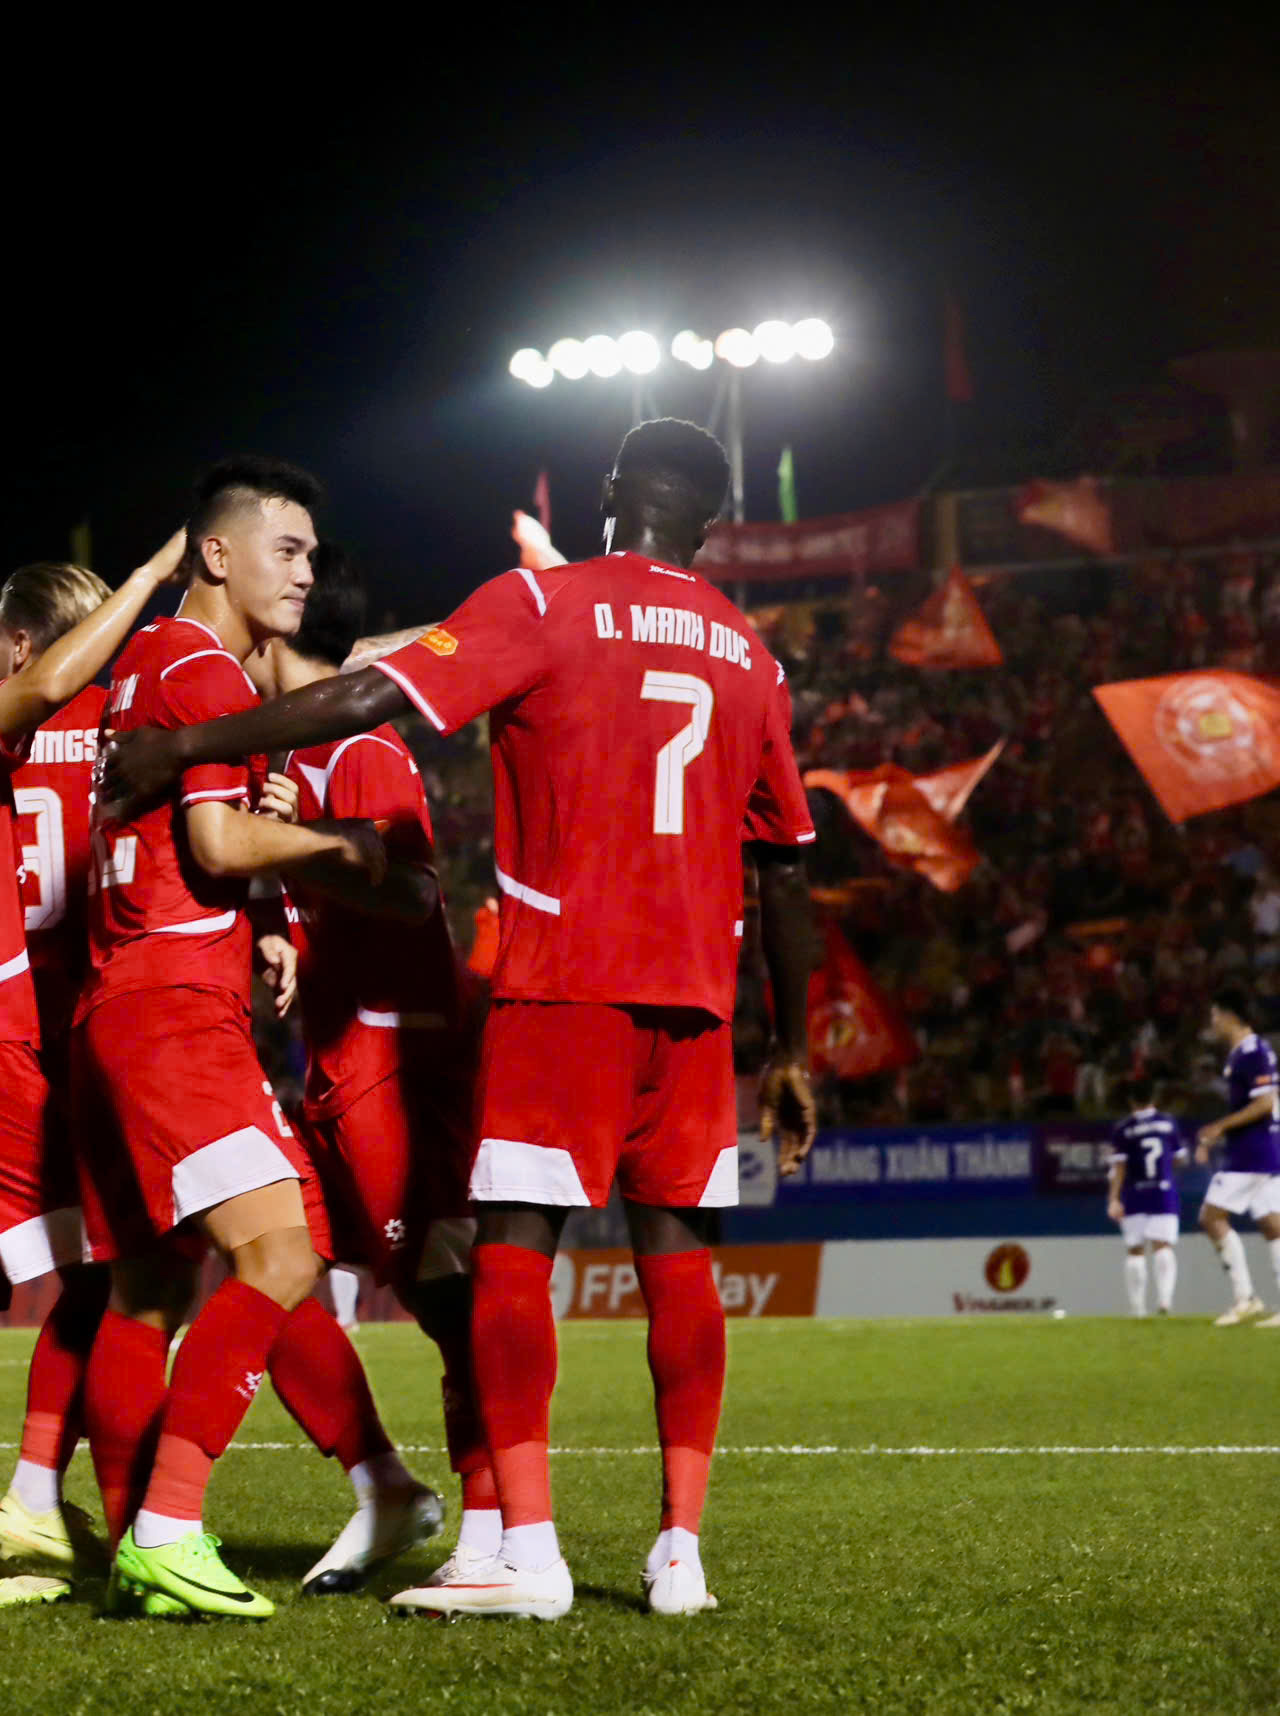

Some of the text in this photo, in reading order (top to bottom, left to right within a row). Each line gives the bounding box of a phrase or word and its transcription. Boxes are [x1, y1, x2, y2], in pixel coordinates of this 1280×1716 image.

[630, 604, 705, 651] MANH
[709, 621, 752, 671] DUC
[640, 669, 715, 835] 7
[1140, 1136, 1164, 1179] 7
[580, 1262, 780, 1318] FP lay
